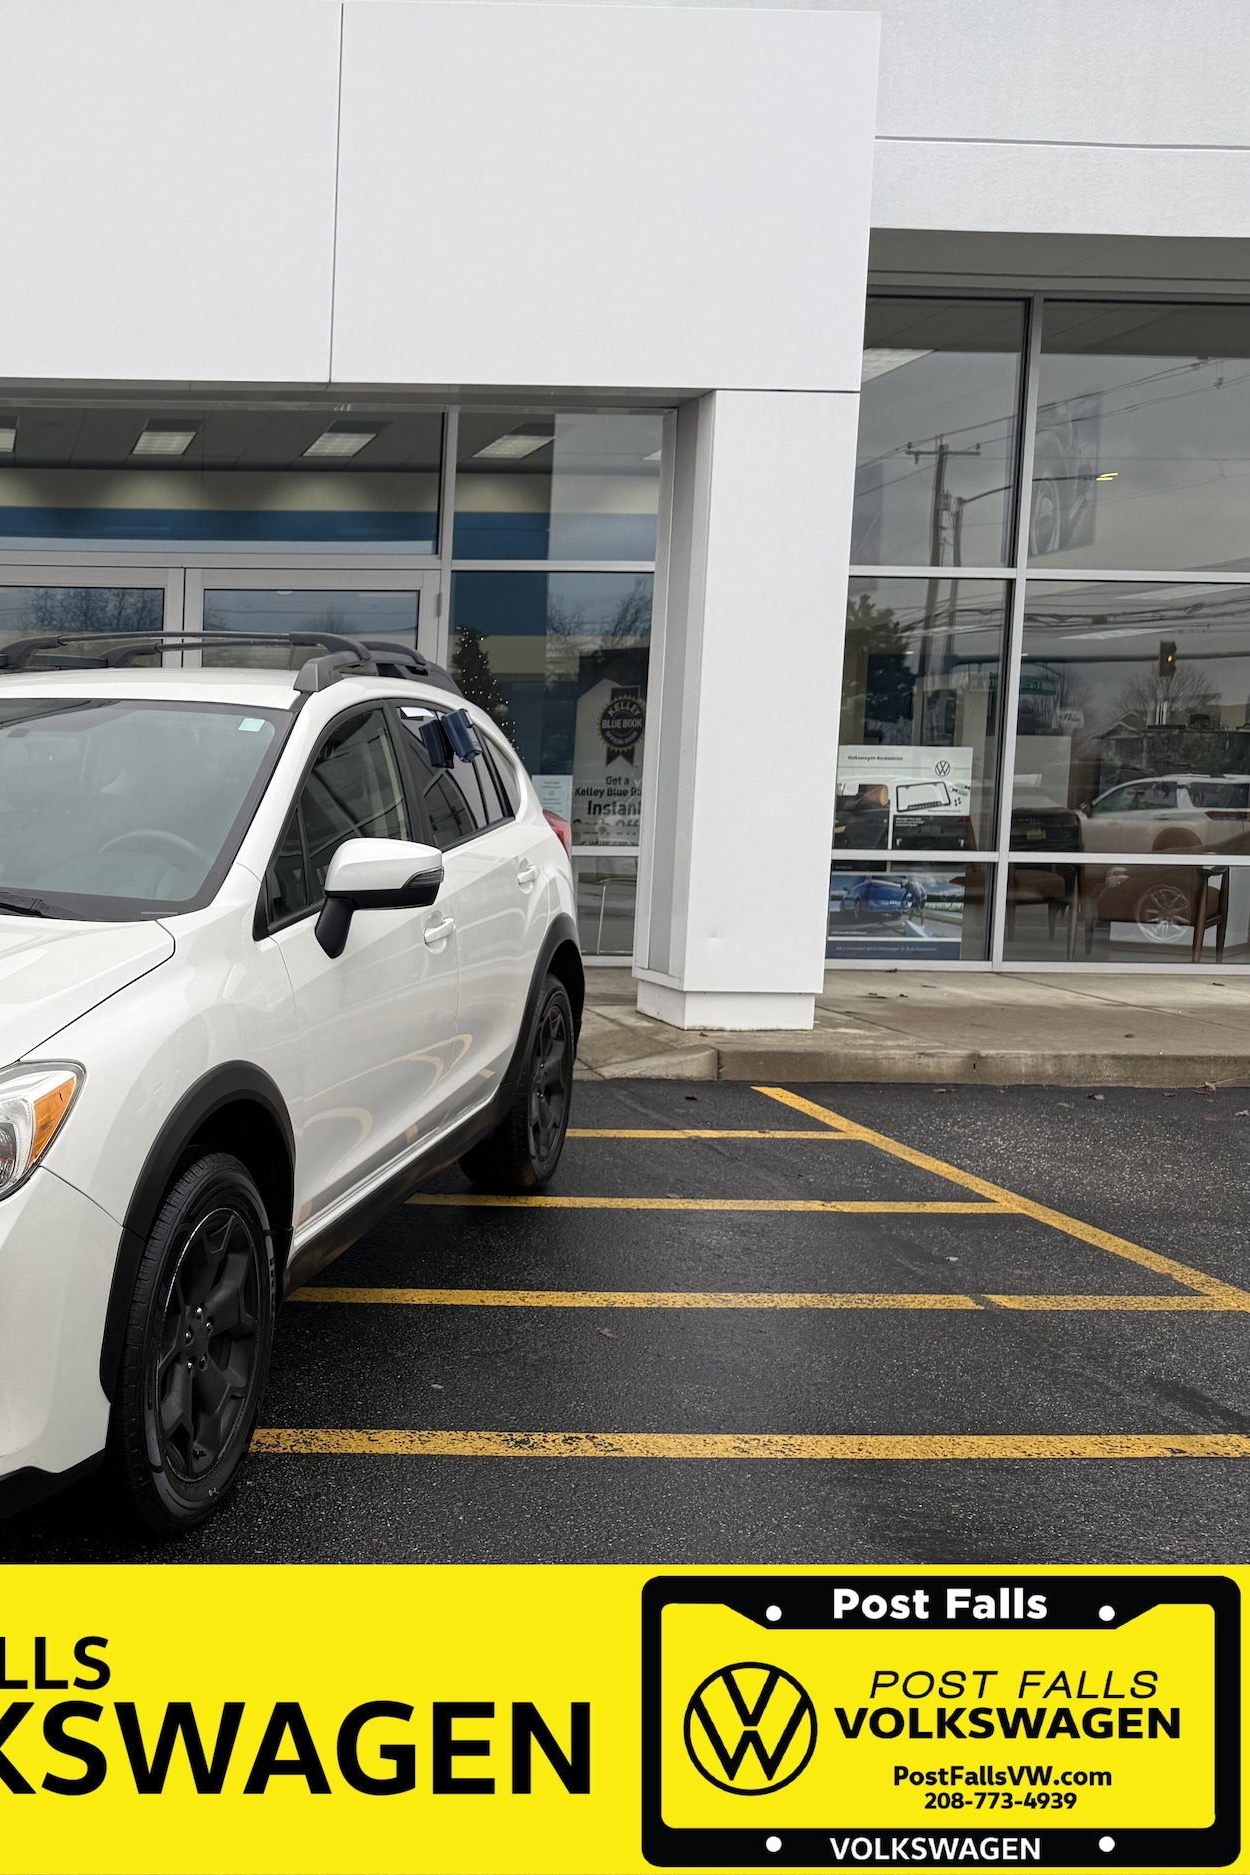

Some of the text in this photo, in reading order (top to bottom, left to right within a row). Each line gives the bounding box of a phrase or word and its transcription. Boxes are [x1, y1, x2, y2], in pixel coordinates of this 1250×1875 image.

[607, 701, 641, 716] KELLEY
[602, 718, 643, 729] BLUE BOOK
[606, 776, 630, 785] Get a
[574, 787, 642, 798] Kelley Blue Bo
